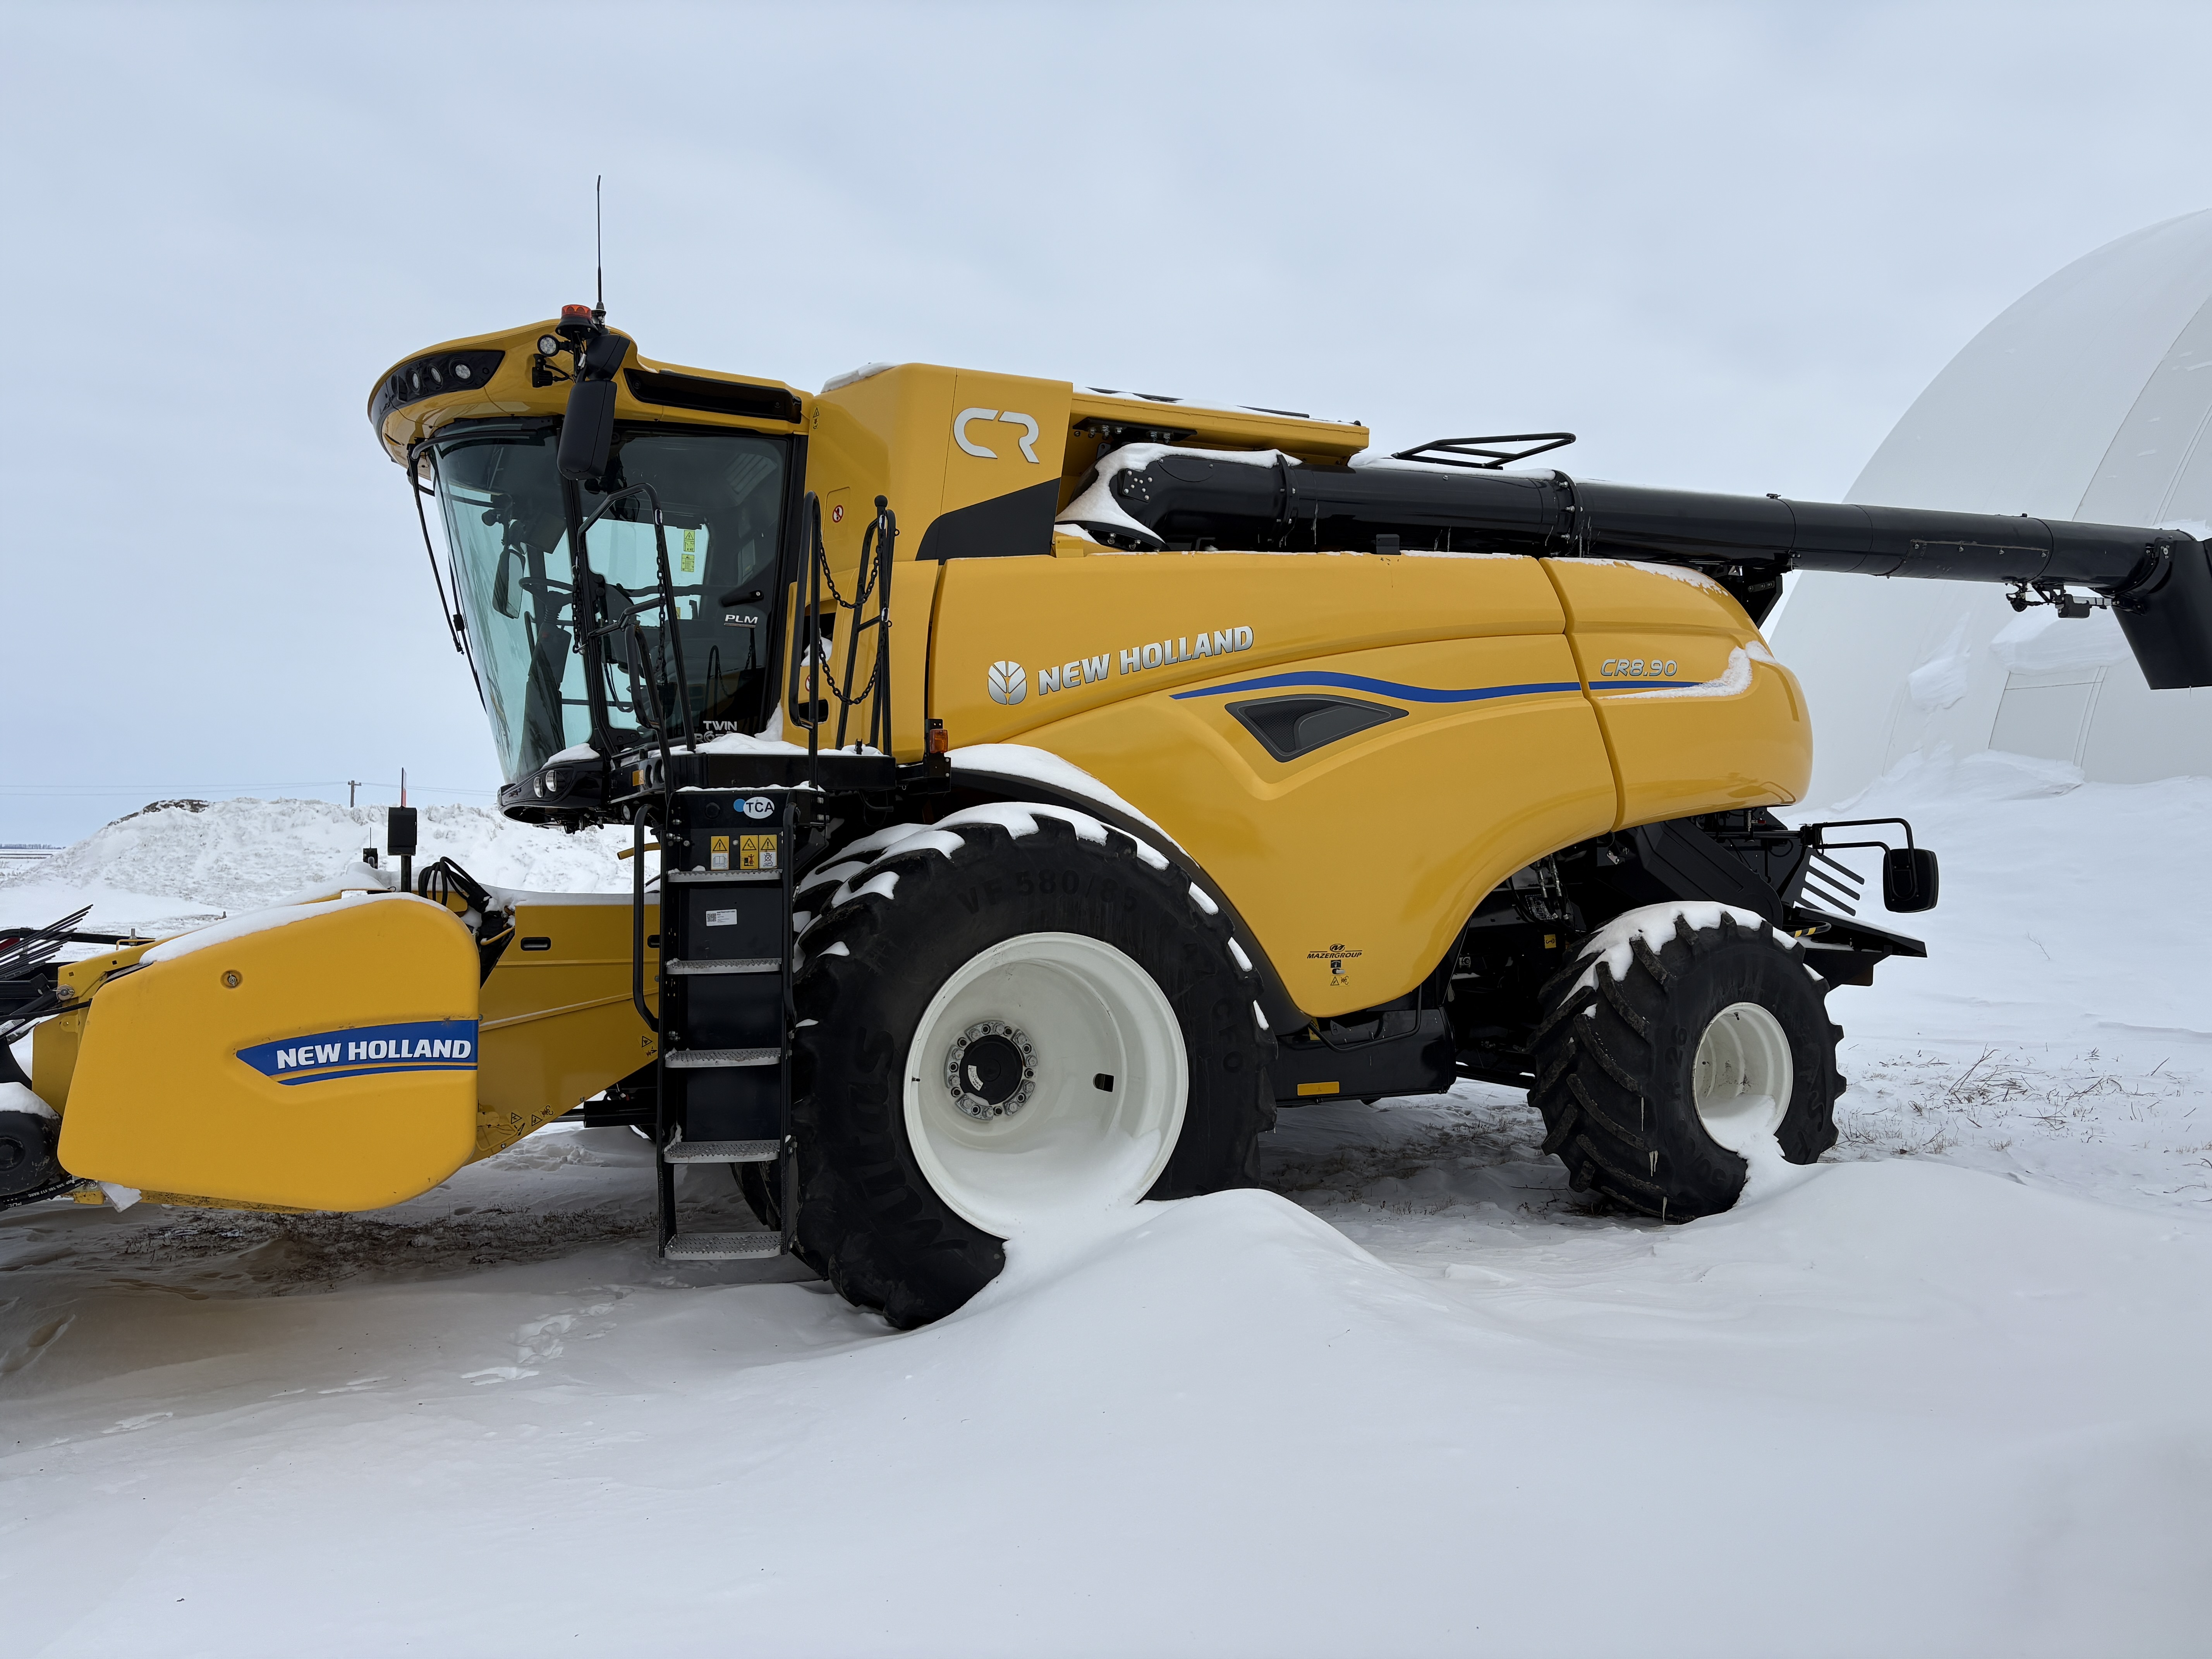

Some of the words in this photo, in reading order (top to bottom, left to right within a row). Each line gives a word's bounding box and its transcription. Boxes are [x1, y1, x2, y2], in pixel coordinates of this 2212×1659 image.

[953, 407, 1040, 464] CR
[725, 614, 758, 624] PLM
[1038, 653, 1110, 696] NEW
[1119, 626, 1254, 675] HOLLAND
[1600, 659, 1678, 677] CR8.90
[703, 720, 737, 731] TWIN
[745, 802, 774, 813] TCA
[957, 877, 1004, 915] VF
[1015, 869, 1140, 913] 580/85
[276, 1043, 341, 1069] NEW
[349, 1039, 471, 1061] HOLLAND
